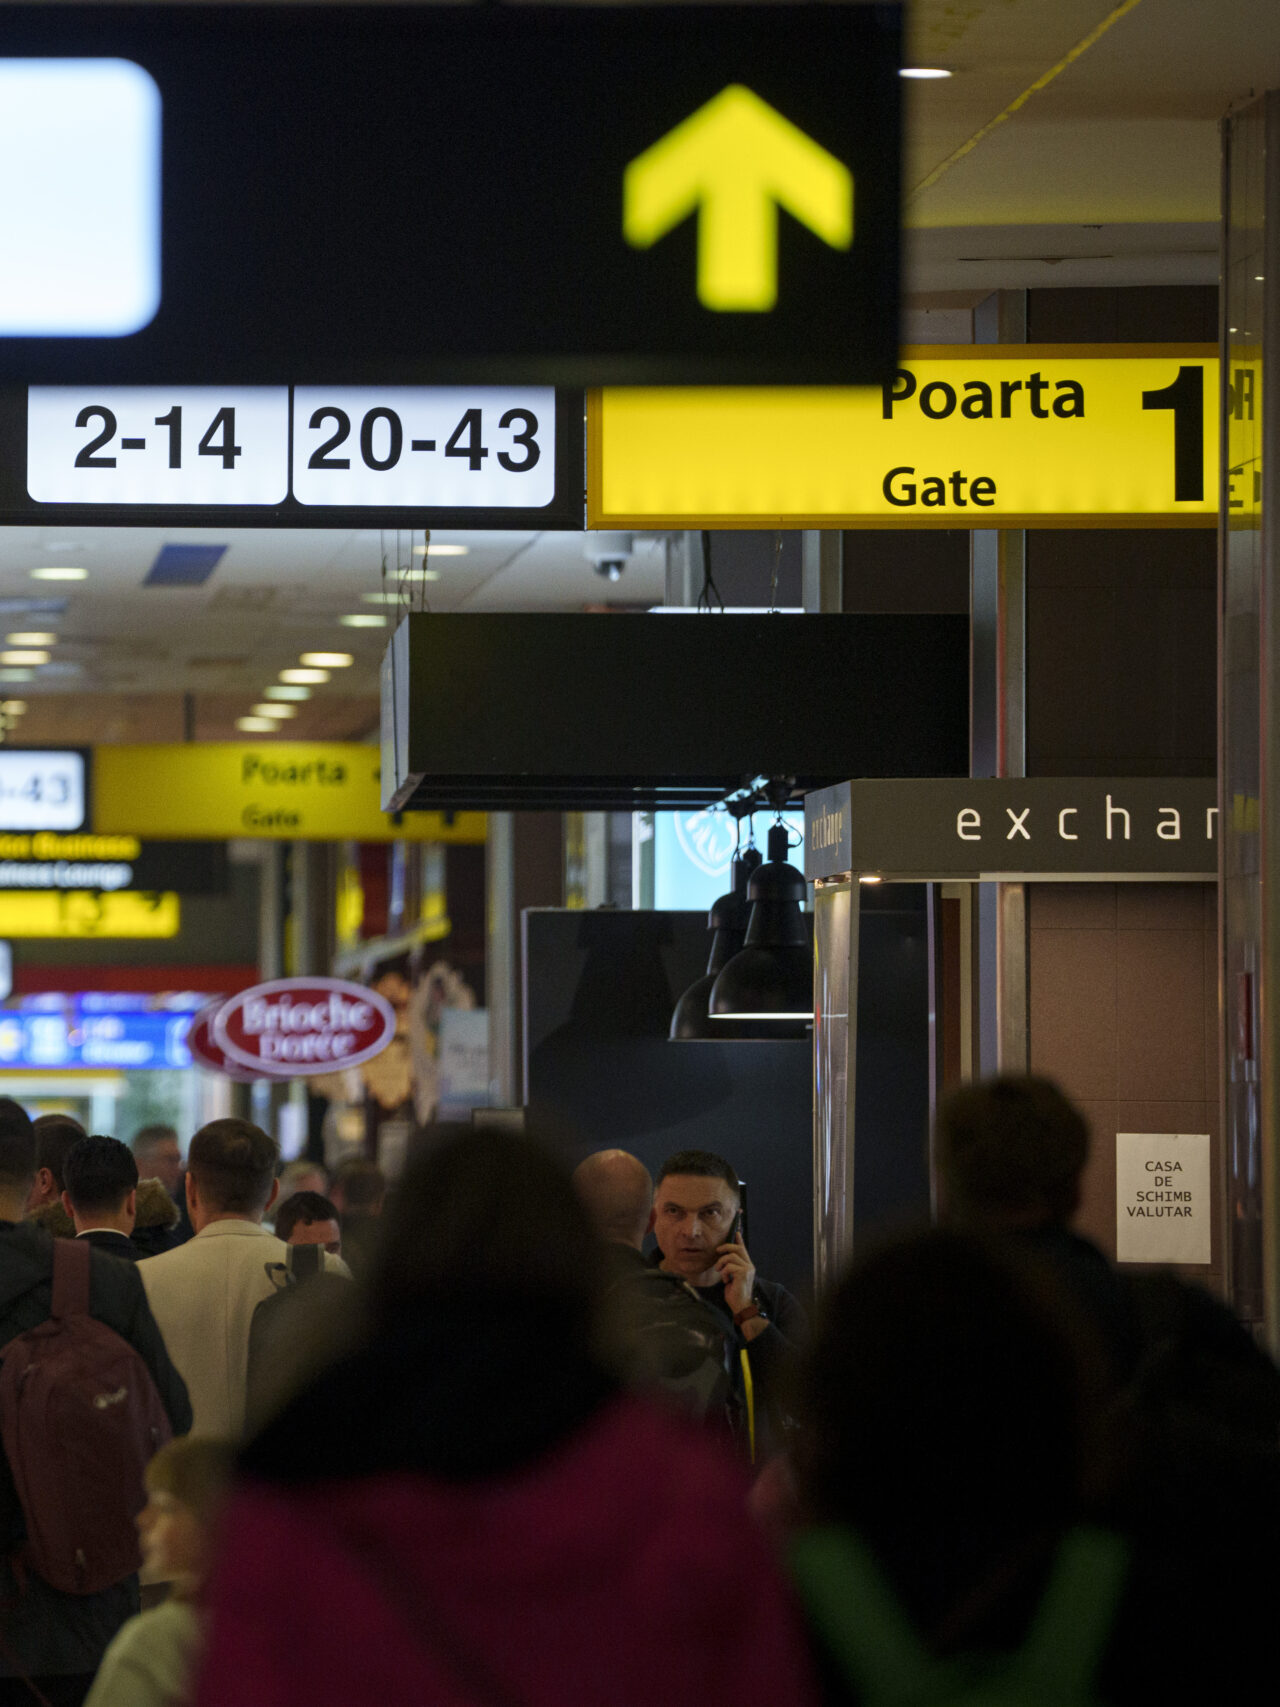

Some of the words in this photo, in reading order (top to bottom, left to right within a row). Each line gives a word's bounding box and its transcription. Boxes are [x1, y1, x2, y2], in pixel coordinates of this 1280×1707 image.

[74, 405, 242, 470] 2-14
[307, 405, 541, 473] 20-43
[882, 368, 1085, 420] Poarta
[1142, 366, 1204, 502] 1
[882, 466, 997, 507] Gate
[242, 754, 349, 786] Poarta
[242, 803, 302, 831] Gate
[243, 993, 375, 1035] Brioche
[1145, 1161, 1183, 1172] CASA
[1154, 1176, 1173, 1187] DE
[1136, 1191, 1192, 1202] SCHIMB
[1127, 1206, 1193, 1218] VALUTAR
